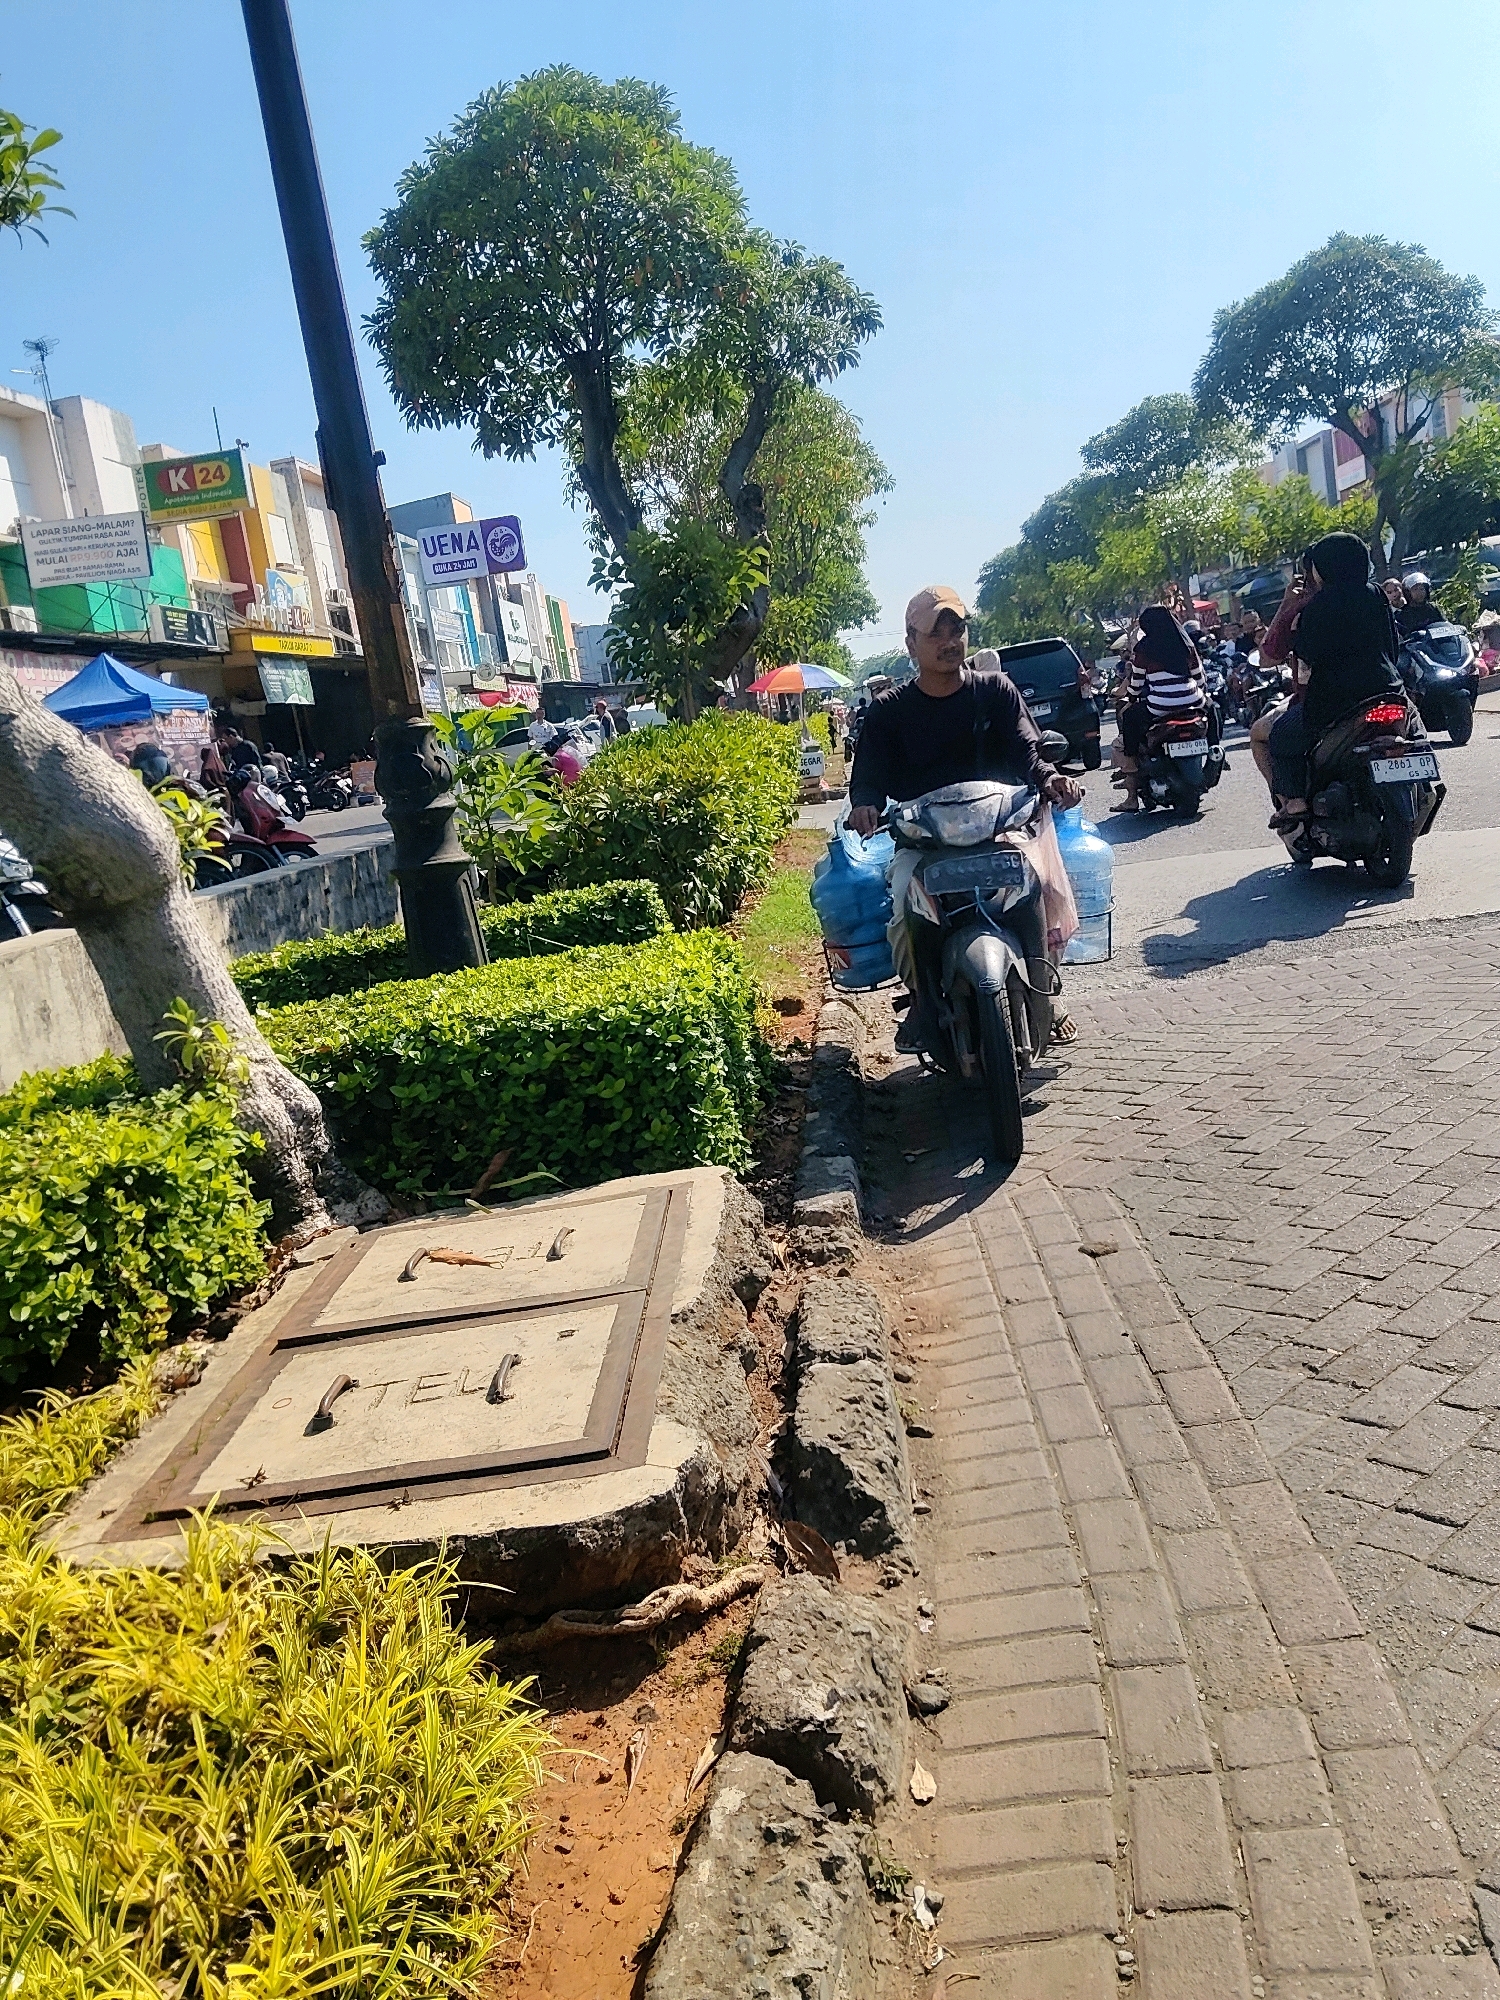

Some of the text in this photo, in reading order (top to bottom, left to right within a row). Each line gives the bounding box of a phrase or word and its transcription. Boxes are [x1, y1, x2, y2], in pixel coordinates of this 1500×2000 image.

[168, 465, 226, 491] K 24
[135, 467, 149, 518] APOTEK
[31, 520, 134, 538] LAPAR SIANG-MALAM?
[62, 534, 93, 542] TUMPAH
[117, 540, 137, 548] JUMBO
[422, 530, 480, 558] UENA
[36, 556, 68, 566] MULAI
[116, 547, 139, 557] AJA!
[83, 562, 125, 570] RAMAI-RAMAI
[434, 559, 476, 573] BUKA 24 JAM
[800, 757, 822, 767] SEGAR
